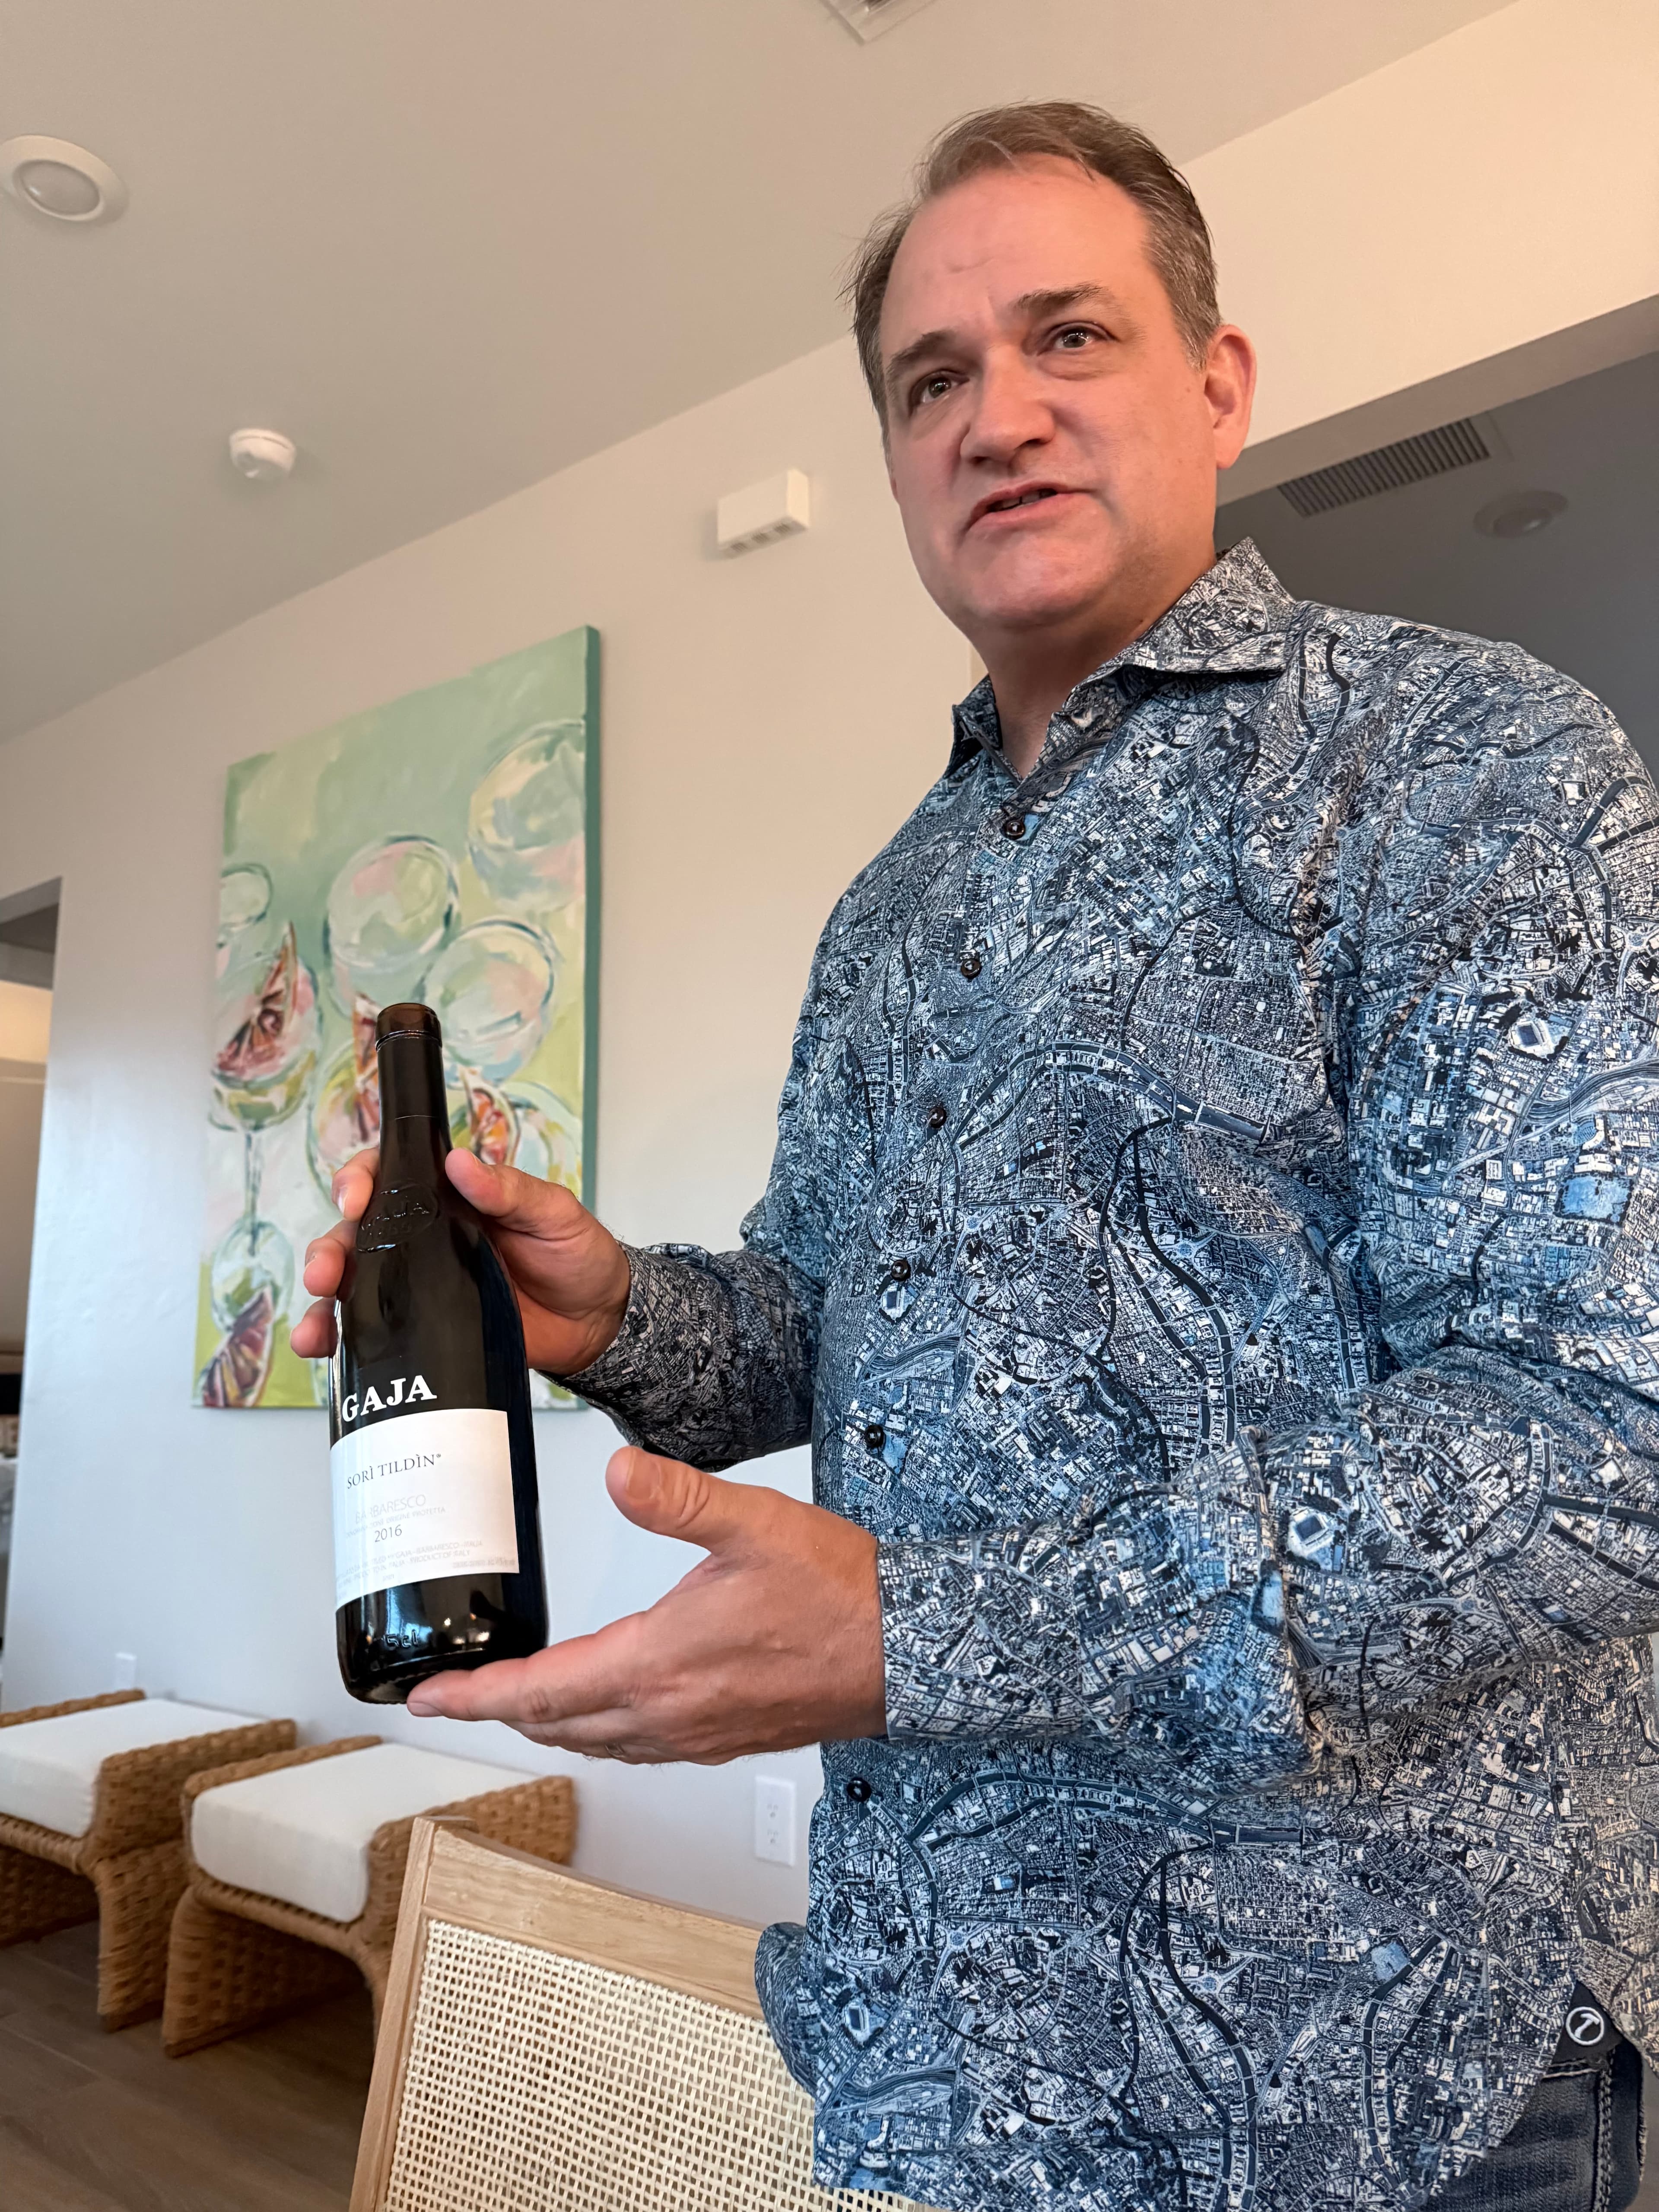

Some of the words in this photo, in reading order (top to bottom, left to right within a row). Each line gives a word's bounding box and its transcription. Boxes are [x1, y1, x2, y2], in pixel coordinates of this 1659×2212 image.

[342, 1375, 437, 1422] GAJA
[347, 1465, 374, 1489] SORÌ
[375, 1524, 402, 1542] 2016
